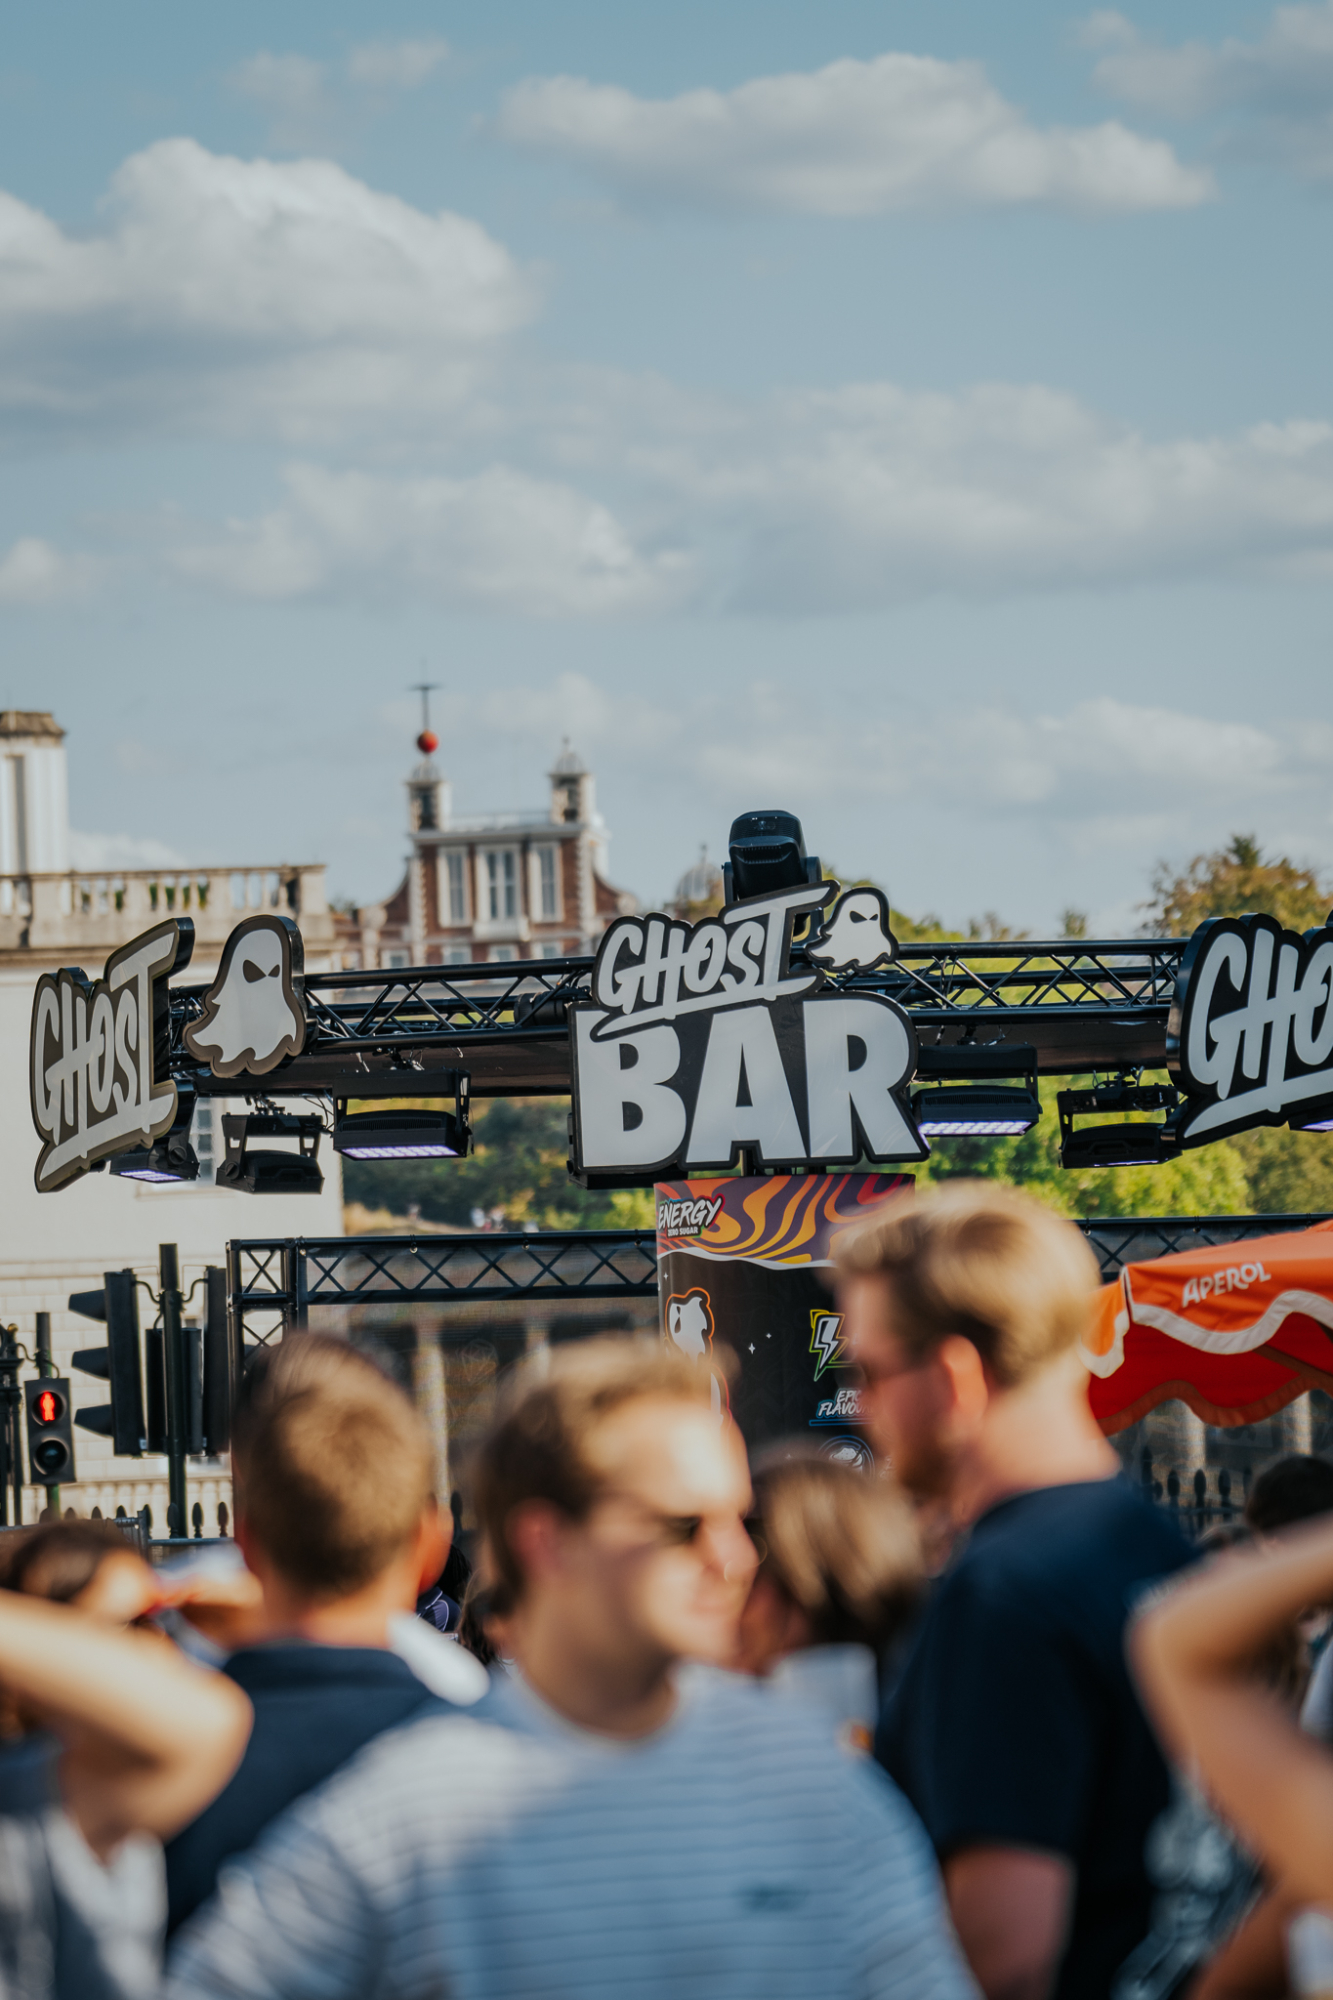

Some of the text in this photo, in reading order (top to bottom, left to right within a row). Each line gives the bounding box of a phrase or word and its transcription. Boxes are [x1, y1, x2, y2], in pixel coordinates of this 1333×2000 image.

[597, 886, 831, 1036] GHOST
[34, 932, 176, 1182] GHOST
[575, 1000, 922, 1168] BAR
[658, 1197, 722, 1230] ENERGY
[667, 1226, 699, 1237] ZERO SUGAR
[1182, 1261, 1272, 1308] APEROL
